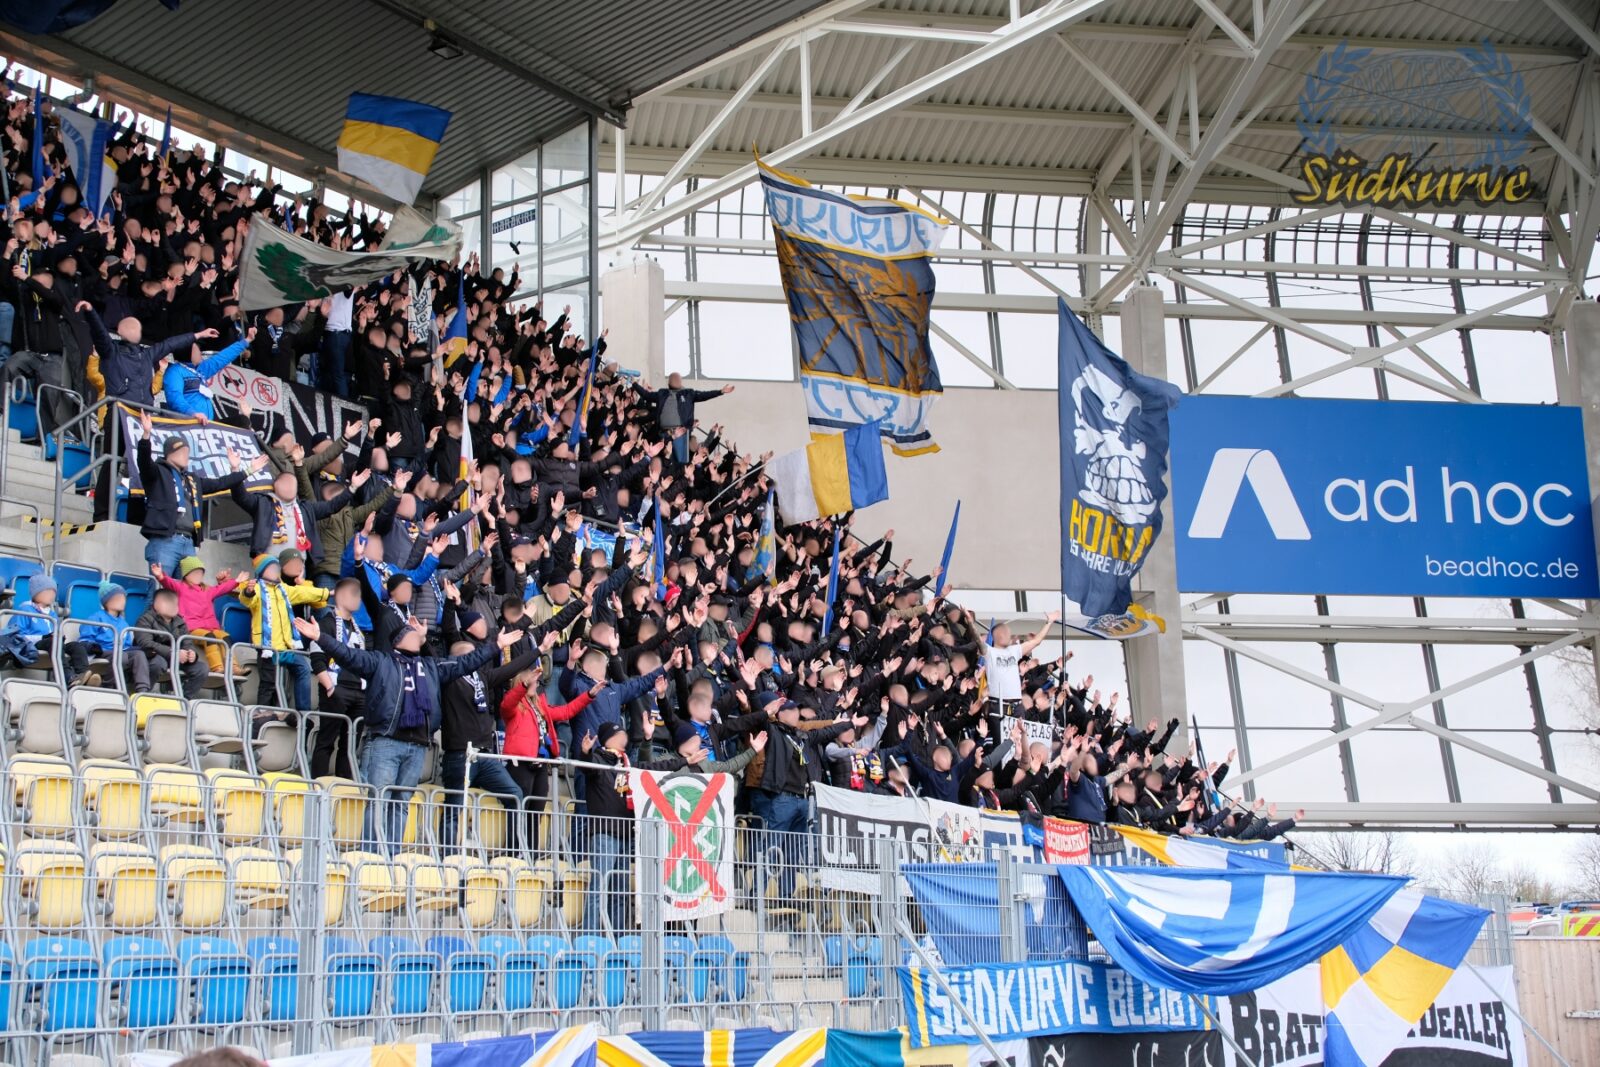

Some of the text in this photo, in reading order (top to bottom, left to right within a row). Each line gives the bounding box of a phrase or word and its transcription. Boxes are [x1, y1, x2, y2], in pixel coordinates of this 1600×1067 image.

[1325, 466, 1575, 526] ad hoc
[1426, 555, 1579, 578] beadhoc.de
[1008, 718, 1052, 740] UTRAS
[928, 963, 1098, 1036] SÜDKURVE
